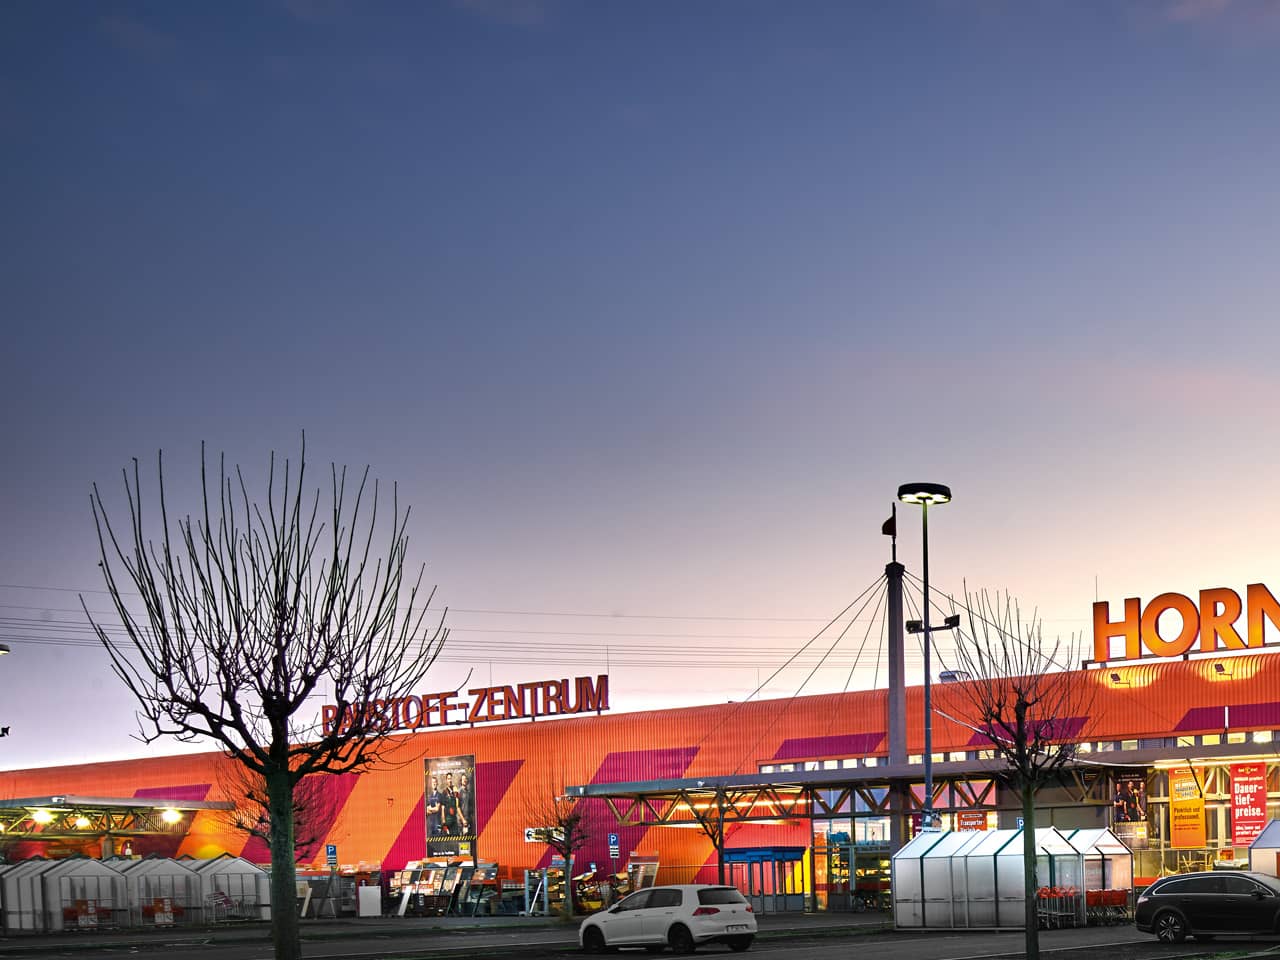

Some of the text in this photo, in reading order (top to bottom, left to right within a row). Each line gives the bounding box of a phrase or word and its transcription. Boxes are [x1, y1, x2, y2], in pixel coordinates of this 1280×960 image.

[1234, 783, 1263, 794] Dauer-
[1235, 794, 1255, 805] tief-
[1235, 805, 1264, 819] preise.
[611, 835, 617, 844] P
[328, 846, 334, 854] P
